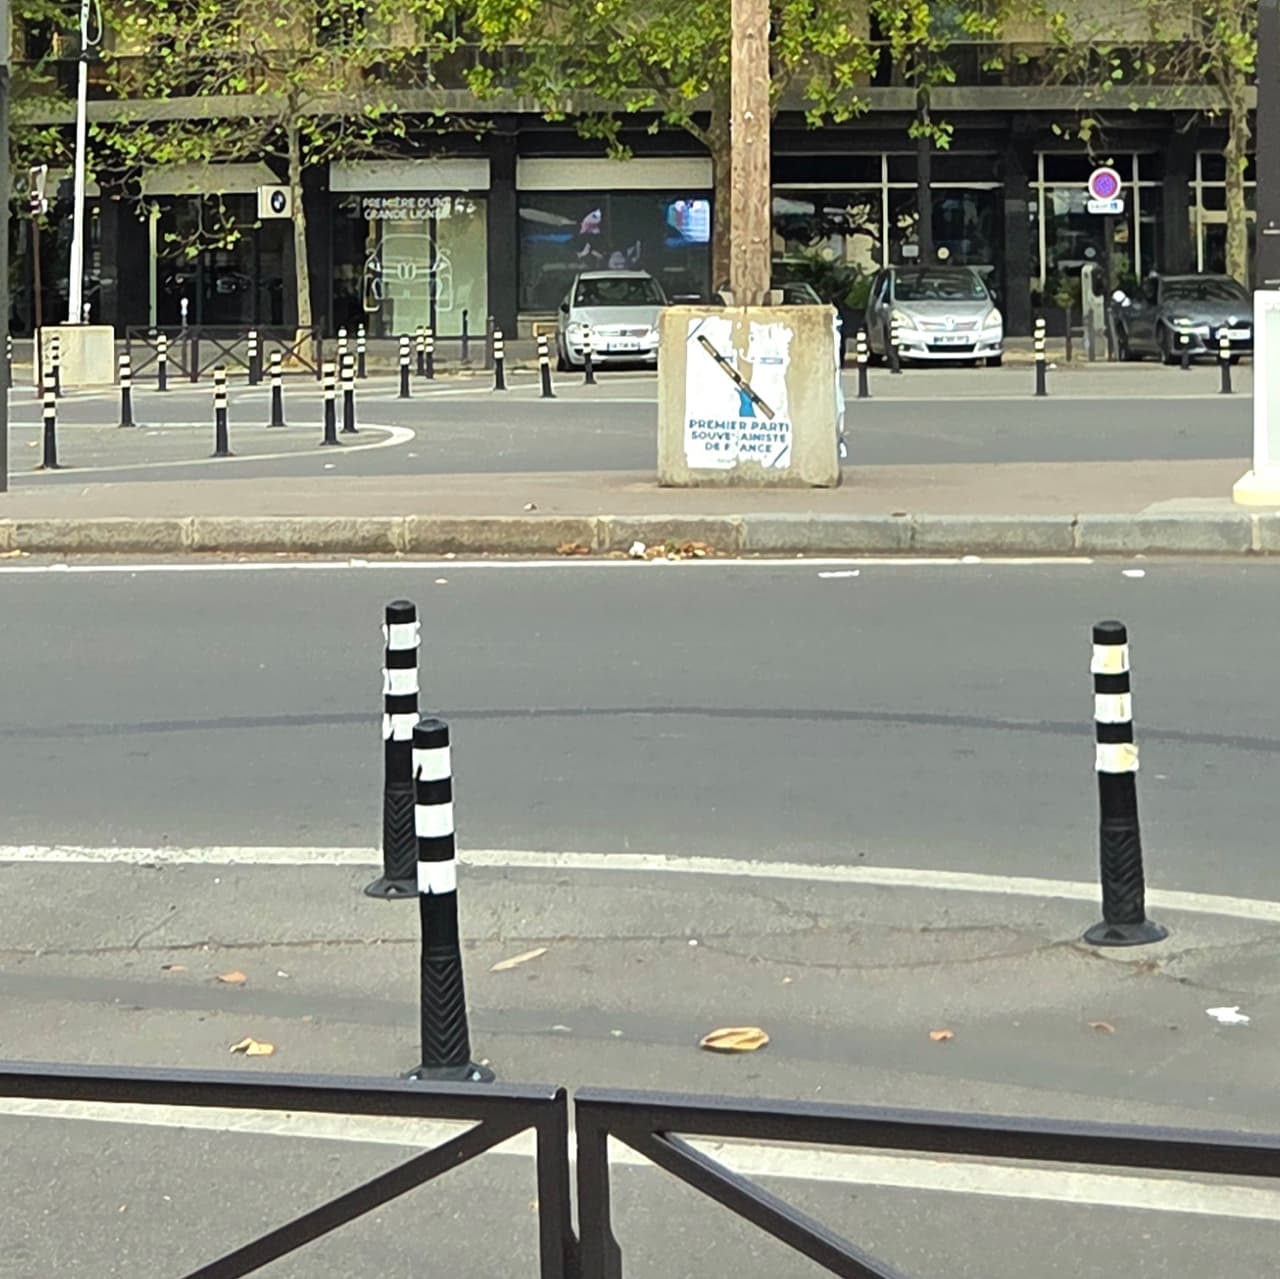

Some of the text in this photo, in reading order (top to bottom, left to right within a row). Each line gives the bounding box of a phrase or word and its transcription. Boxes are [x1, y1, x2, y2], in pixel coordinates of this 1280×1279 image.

[363, 208, 407, 220] GRANDE
[689, 419, 789, 432] PREMIER PARTI
[691, 431, 786, 443] SOUVEAINISTE
[705, 442, 772, 453] DE FANCE
